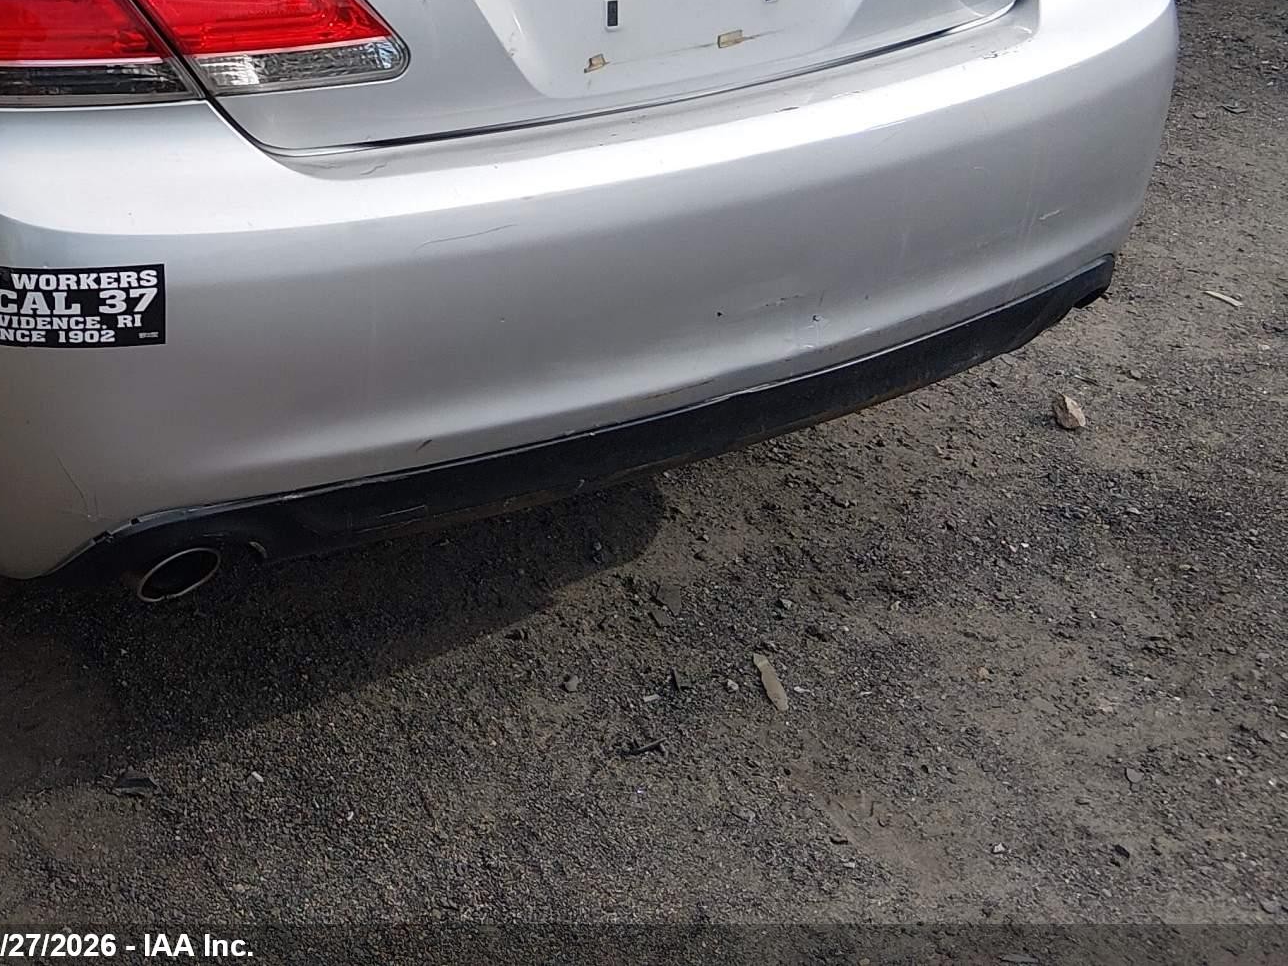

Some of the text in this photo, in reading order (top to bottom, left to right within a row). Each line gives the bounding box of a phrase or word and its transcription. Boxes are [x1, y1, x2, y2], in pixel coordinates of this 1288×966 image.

[11, 269, 158, 291] WORKERS
[98, 287, 158, 314] 37
[117, 314, 143, 328] RI
[58, 330, 116, 343] 1902
